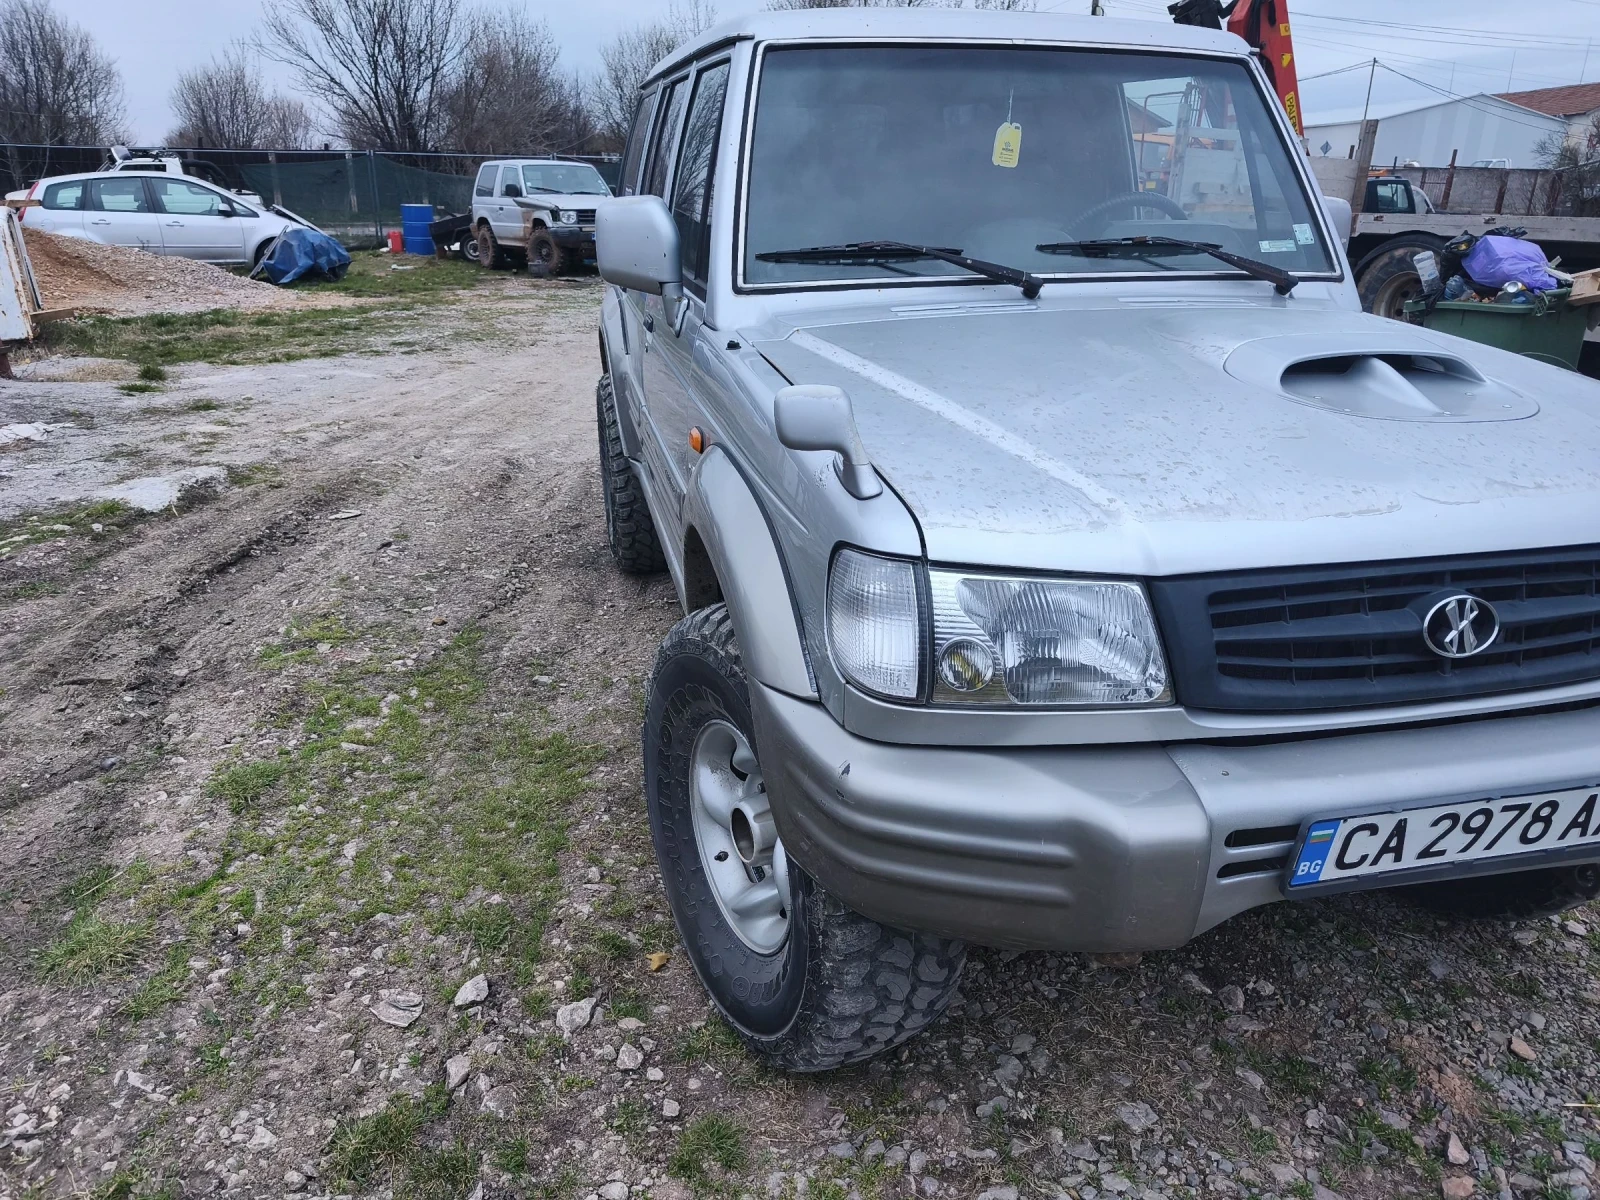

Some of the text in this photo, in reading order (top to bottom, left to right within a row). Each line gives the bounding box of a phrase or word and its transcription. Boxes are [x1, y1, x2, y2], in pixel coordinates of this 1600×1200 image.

[1335, 793, 1600, 870] CA 2978 A
[1297, 859, 1322, 876] BG
